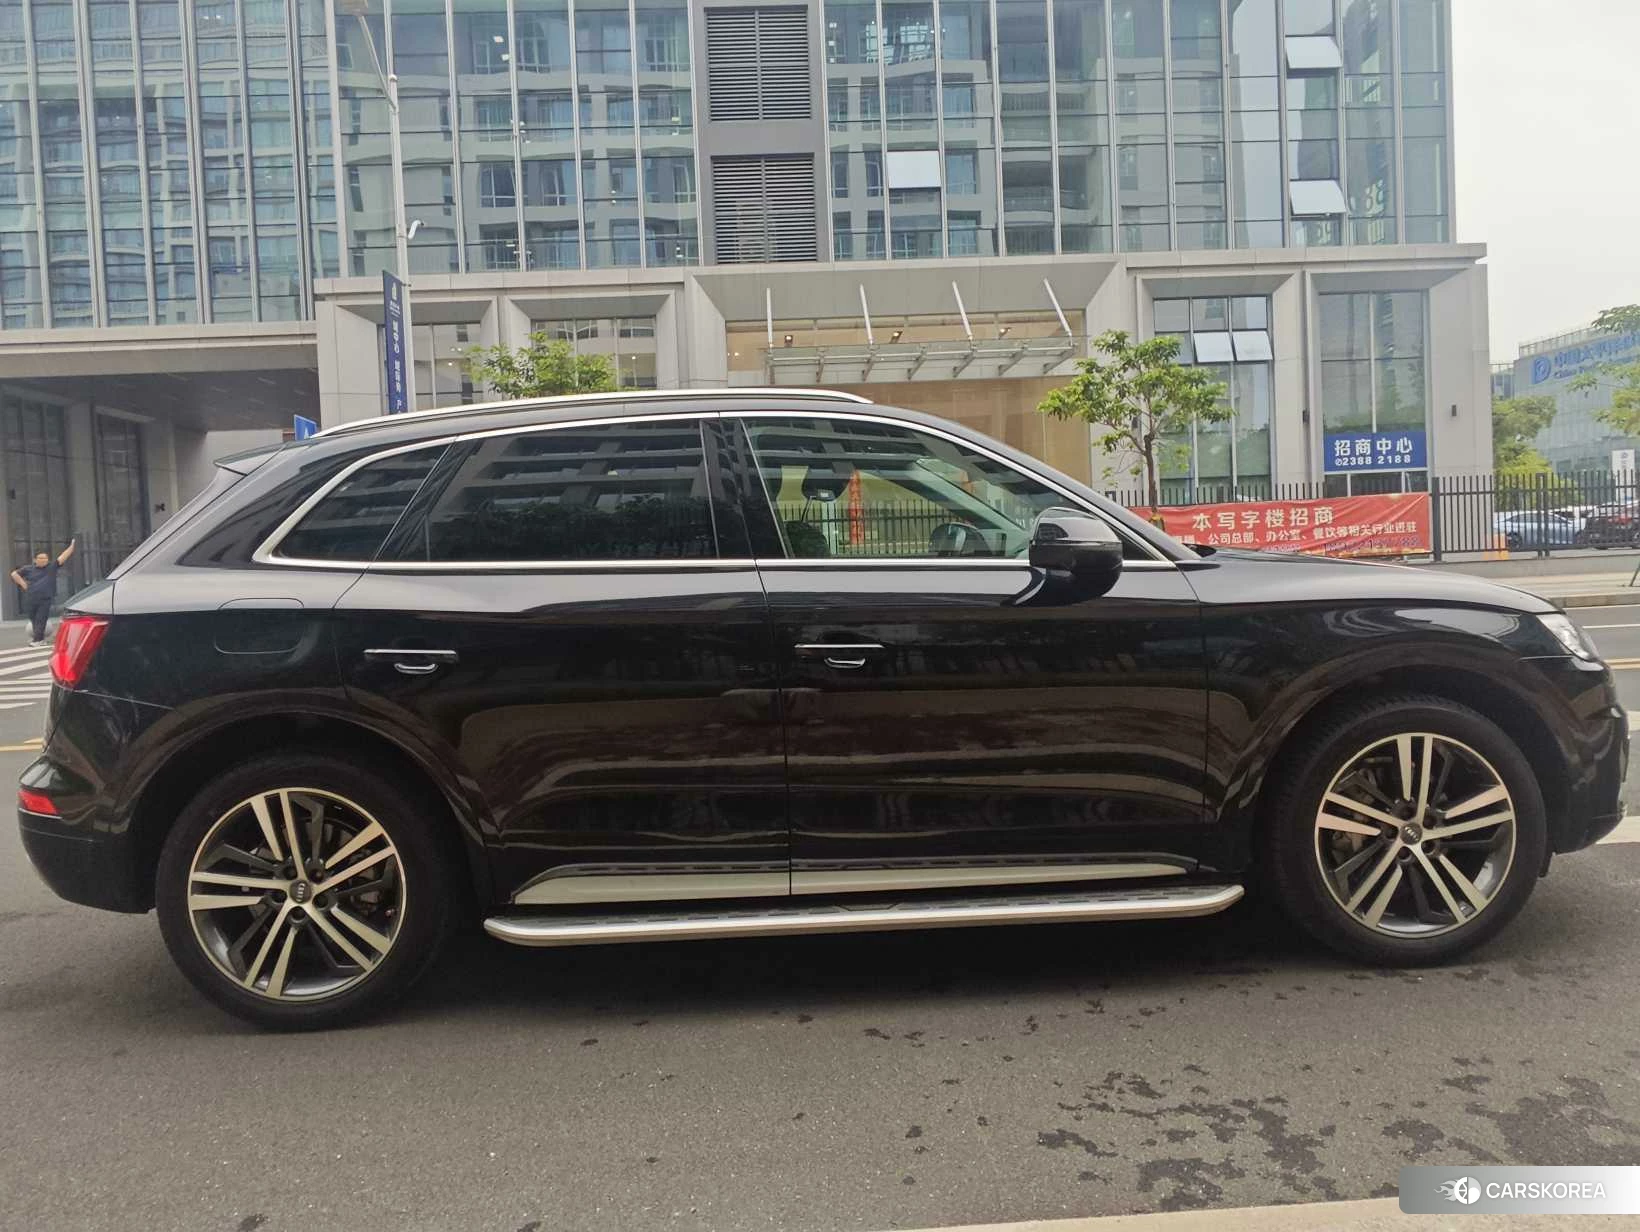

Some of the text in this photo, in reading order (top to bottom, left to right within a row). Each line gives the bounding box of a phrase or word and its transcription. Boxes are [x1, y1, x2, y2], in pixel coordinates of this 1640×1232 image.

[1334, 436, 1413, 457] 招商中心
[1377, 454, 1411, 464] 2188
[1192, 506, 1333, 532] 本写字楼招商
